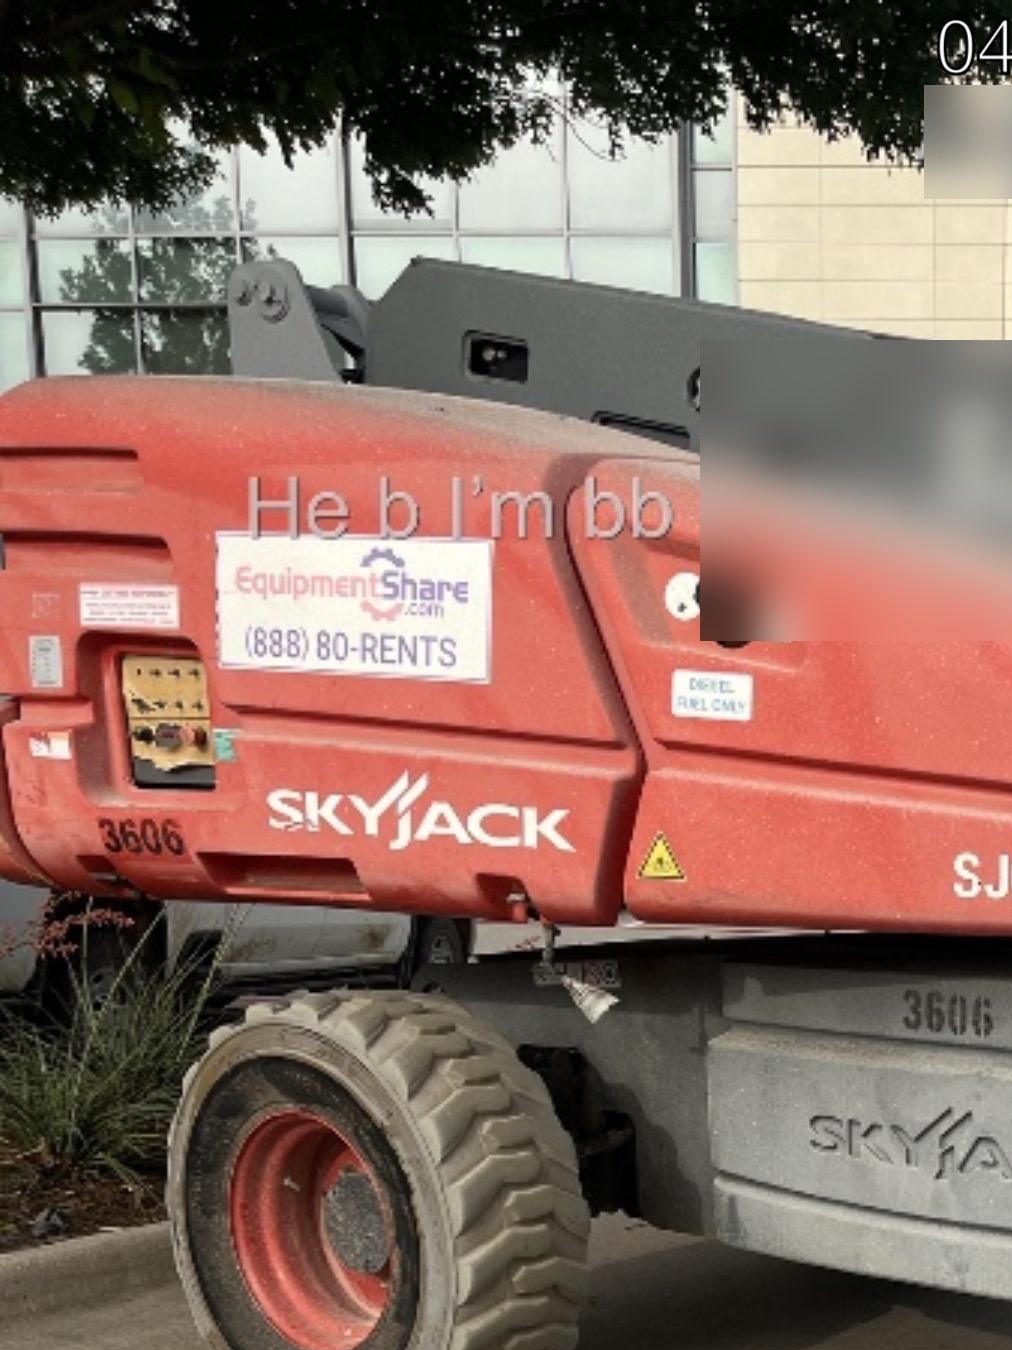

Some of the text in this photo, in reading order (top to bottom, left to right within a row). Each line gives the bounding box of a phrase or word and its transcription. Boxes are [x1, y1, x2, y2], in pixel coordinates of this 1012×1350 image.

[234, 565, 470, 603] EquipmentShare
[245, 626, 457, 667] (888) 80-RENTS
[266, 769, 577, 853] SKYJACK
[99, 817, 184, 856] 3606
[903, 989, 994, 1038] 3606
